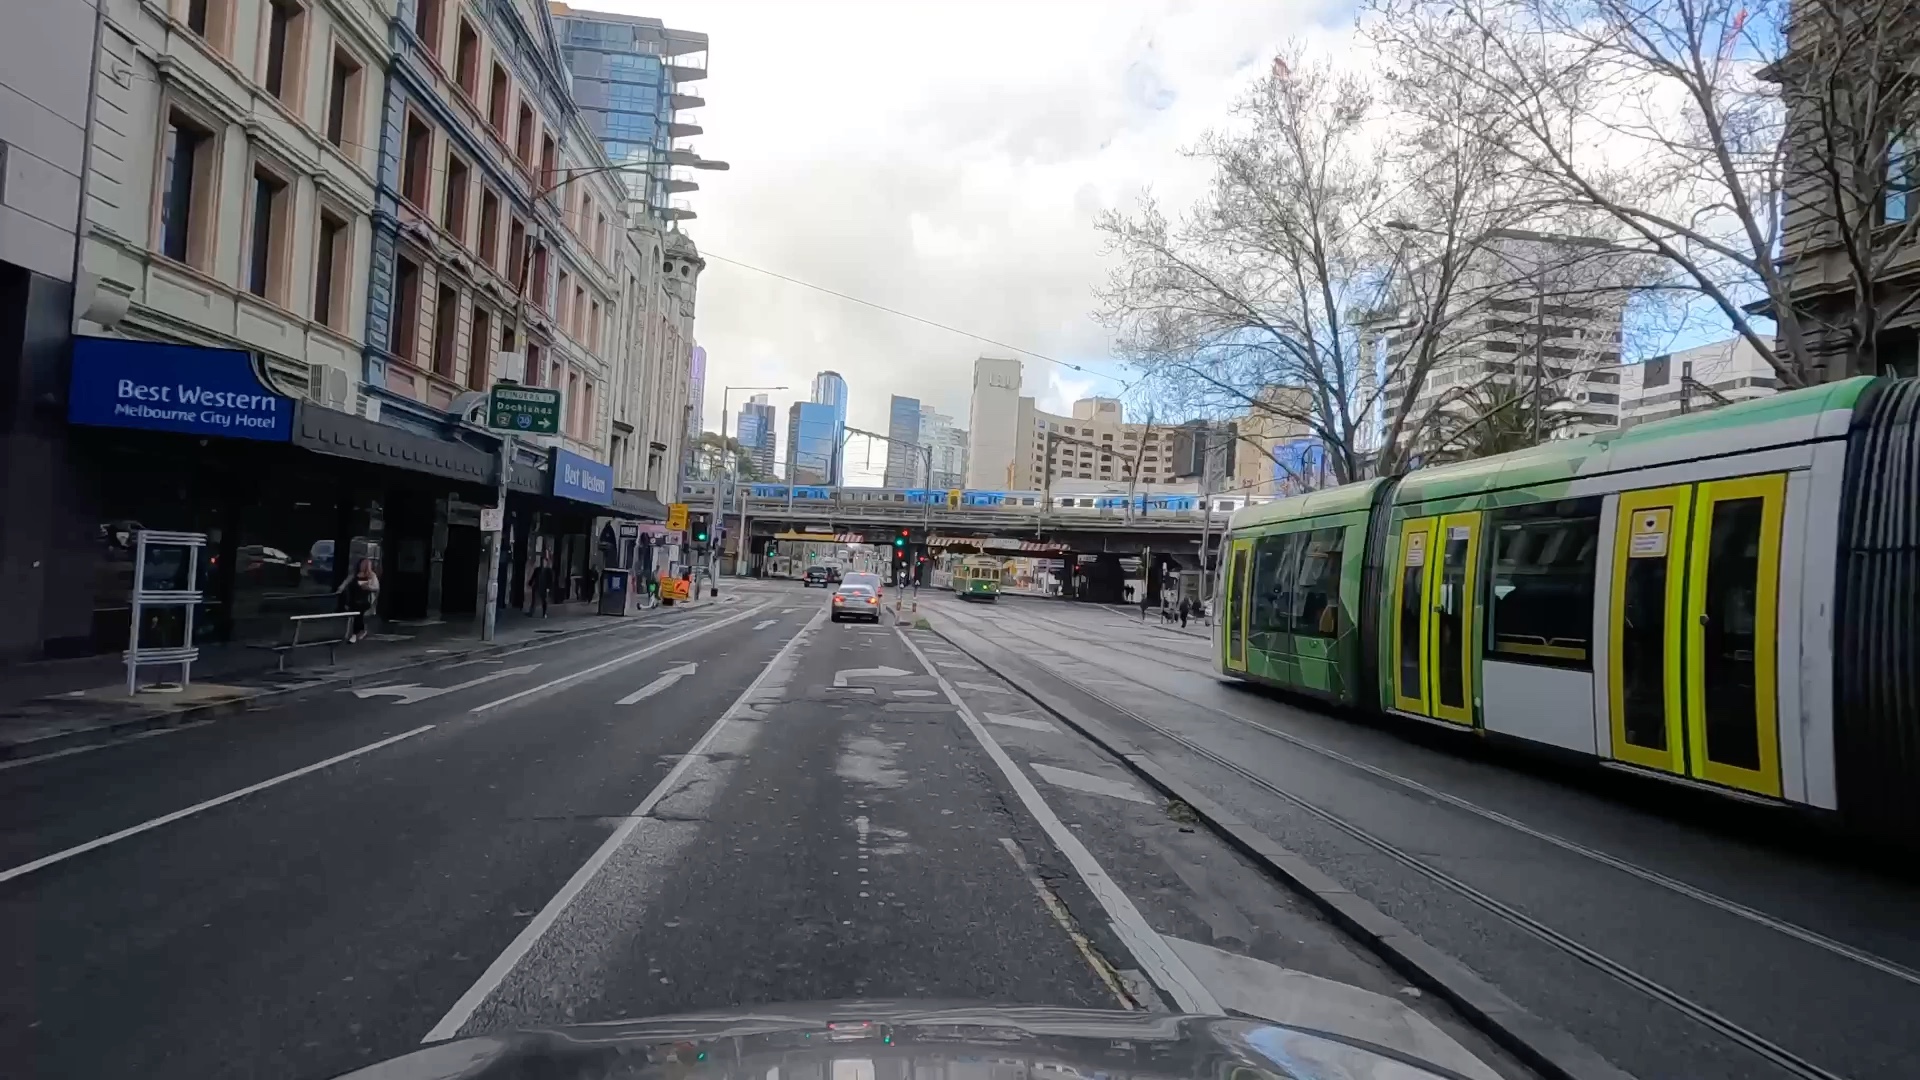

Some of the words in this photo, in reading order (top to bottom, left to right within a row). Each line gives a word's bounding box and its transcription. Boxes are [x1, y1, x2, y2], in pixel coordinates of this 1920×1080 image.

[118, 379, 171, 402] Best
[178, 384, 276, 412] Western
[497, 401, 552, 414] Docklands
[114, 403, 197, 422] Melbourne
[200, 411, 231, 427] City
[235, 414, 275, 428] Hotel
[564, 463, 580, 487] Best
[581, 469, 606, 494] Western
